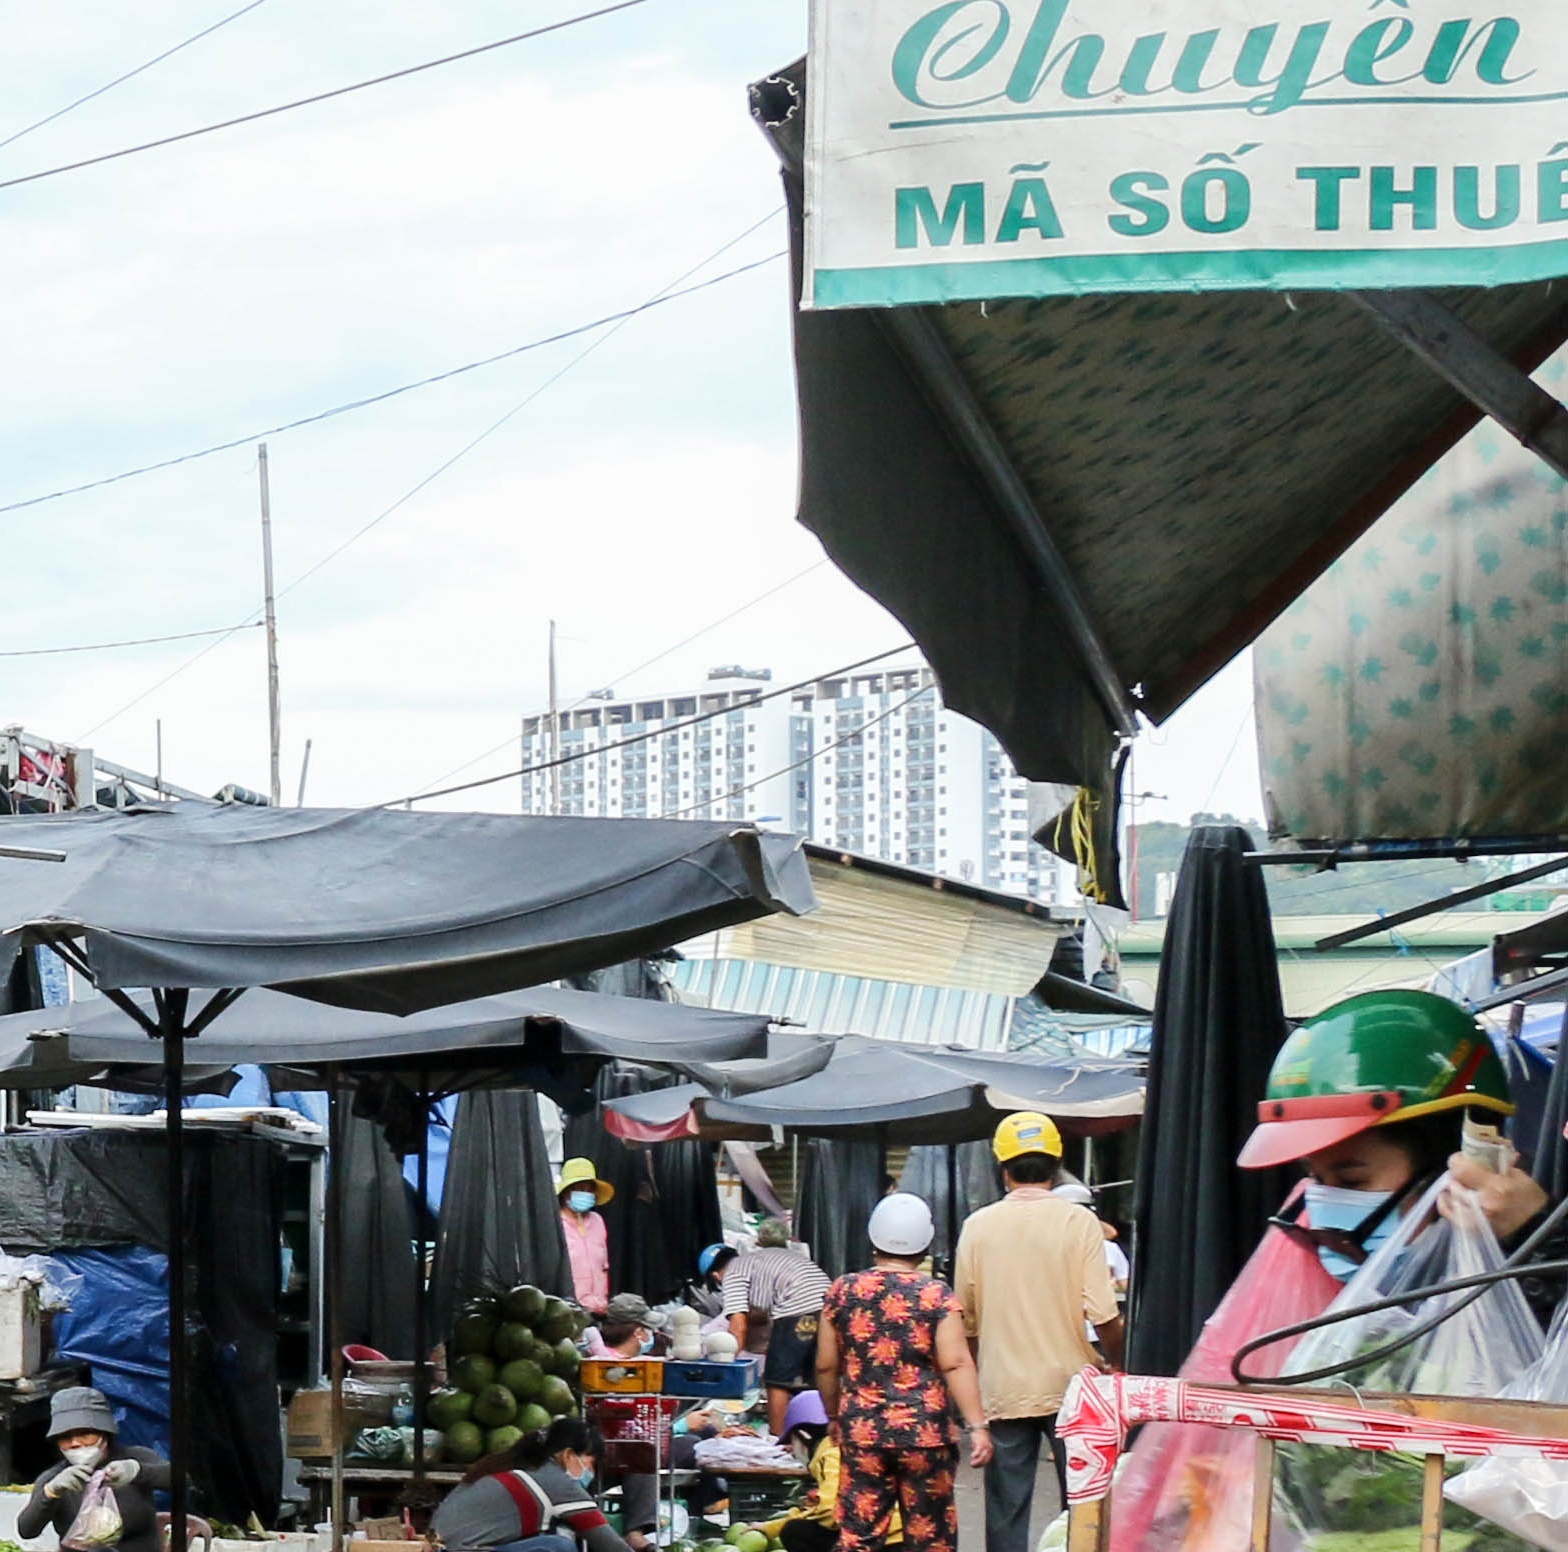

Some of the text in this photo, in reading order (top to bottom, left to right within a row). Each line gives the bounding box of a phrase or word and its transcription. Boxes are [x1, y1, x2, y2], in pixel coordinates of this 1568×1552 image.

[890, 0, 1538, 114] Chuyên
[893, 161, 1065, 249] MÃ
[1107, 143, 1262, 237] SỐ
